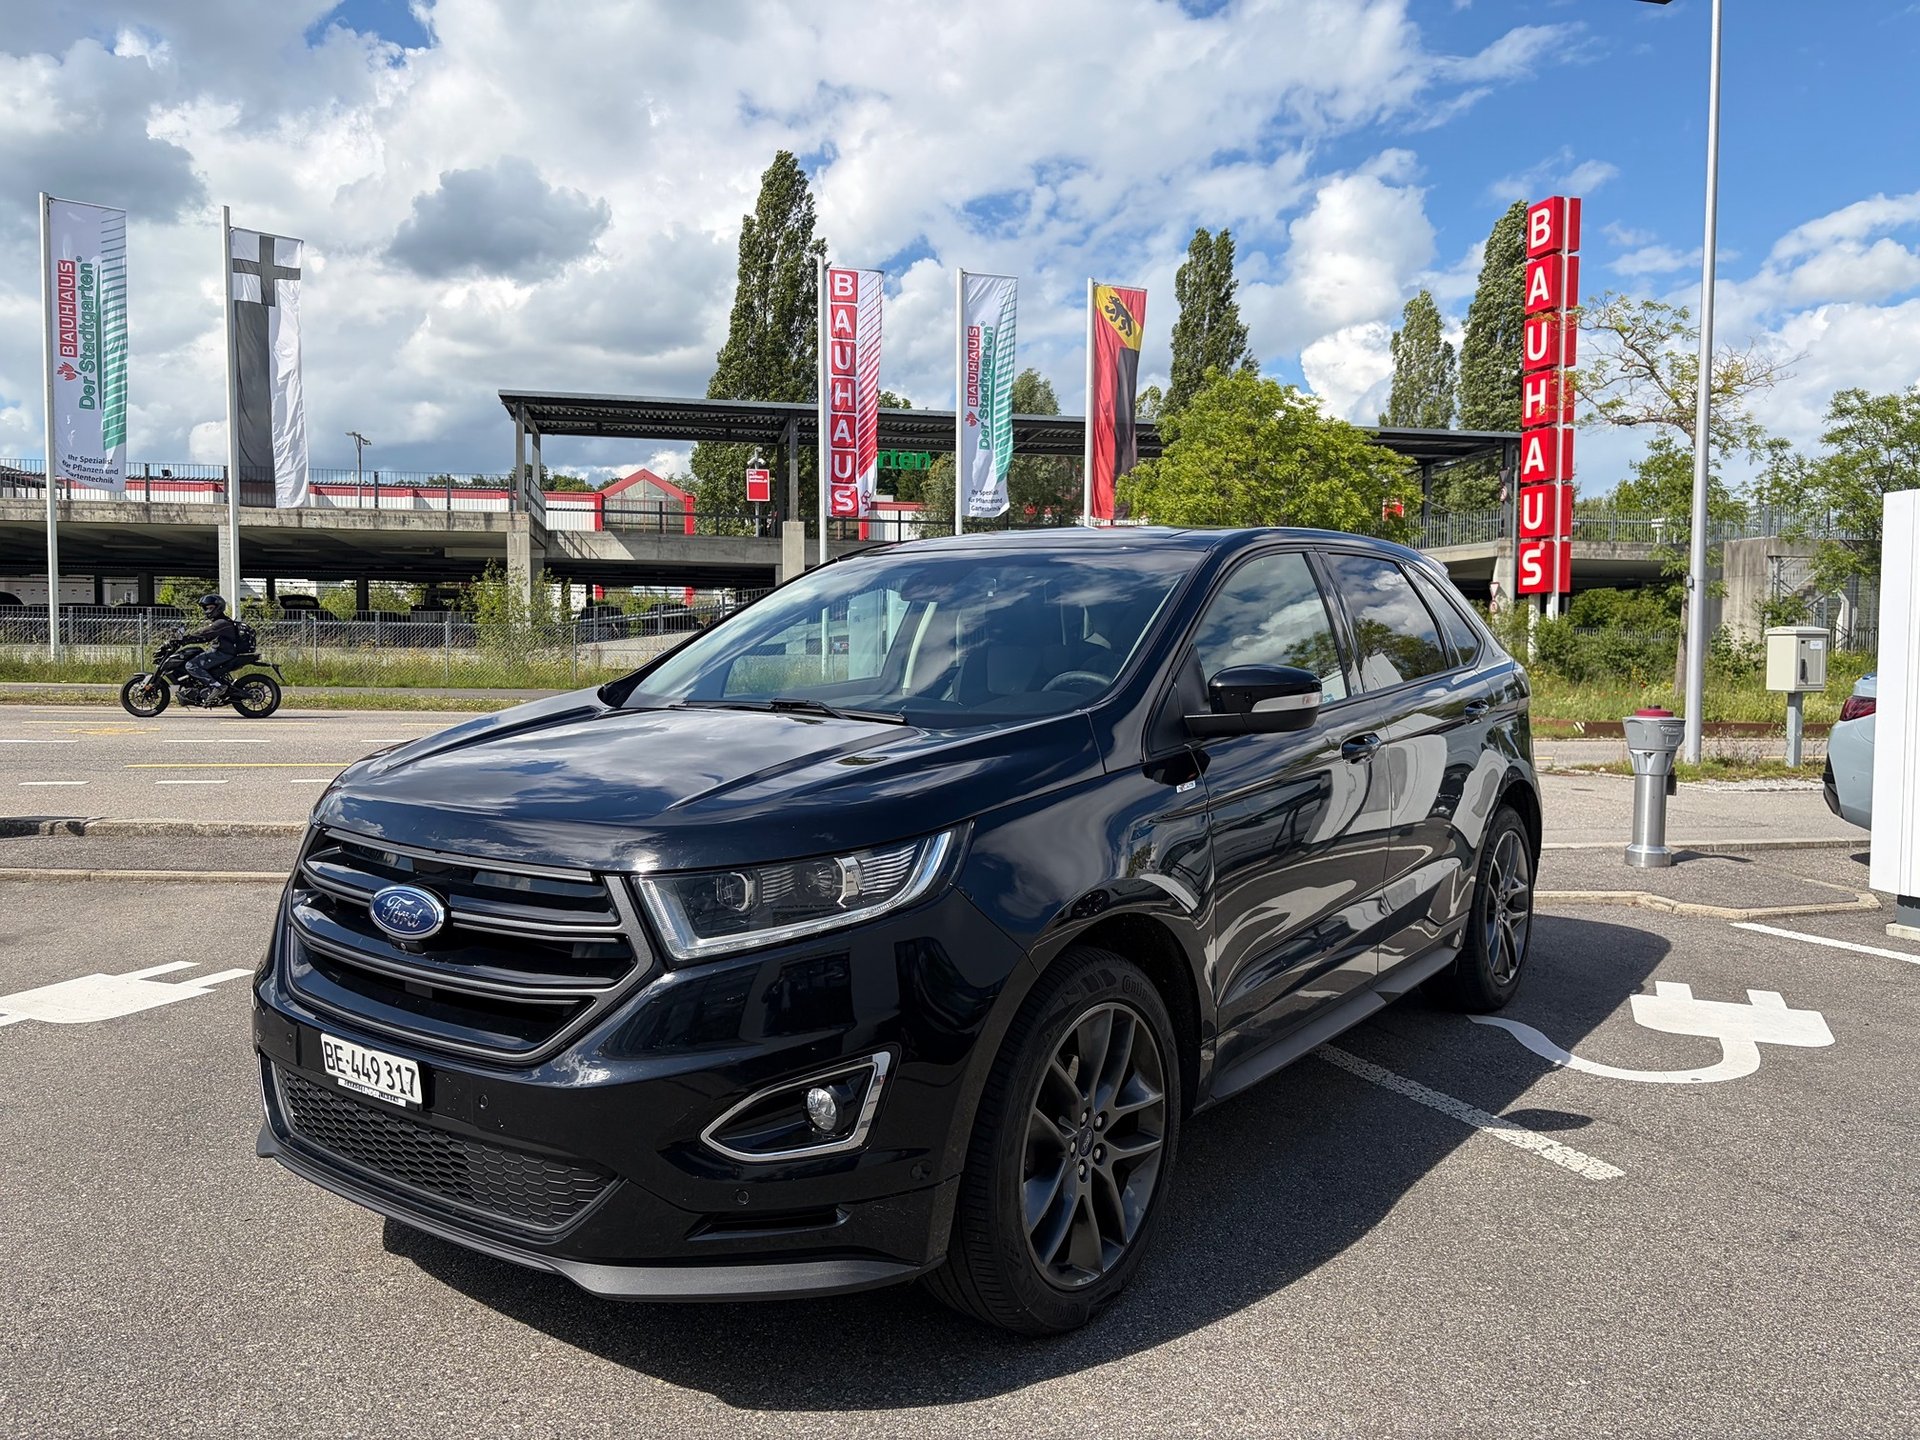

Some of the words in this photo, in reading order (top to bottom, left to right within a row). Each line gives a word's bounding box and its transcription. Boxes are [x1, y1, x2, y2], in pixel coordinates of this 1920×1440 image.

[59, 261, 76, 356] BAUHAUS
[79, 376, 95, 410] Der
[832, 272, 855, 511] BAUHAUS
[968, 327, 979, 406] BAUHAUS
[1521, 207, 1552, 587] BAUHAUS
[72, 463, 104, 474] Pflanzen
[979, 422, 990, 450] Der
